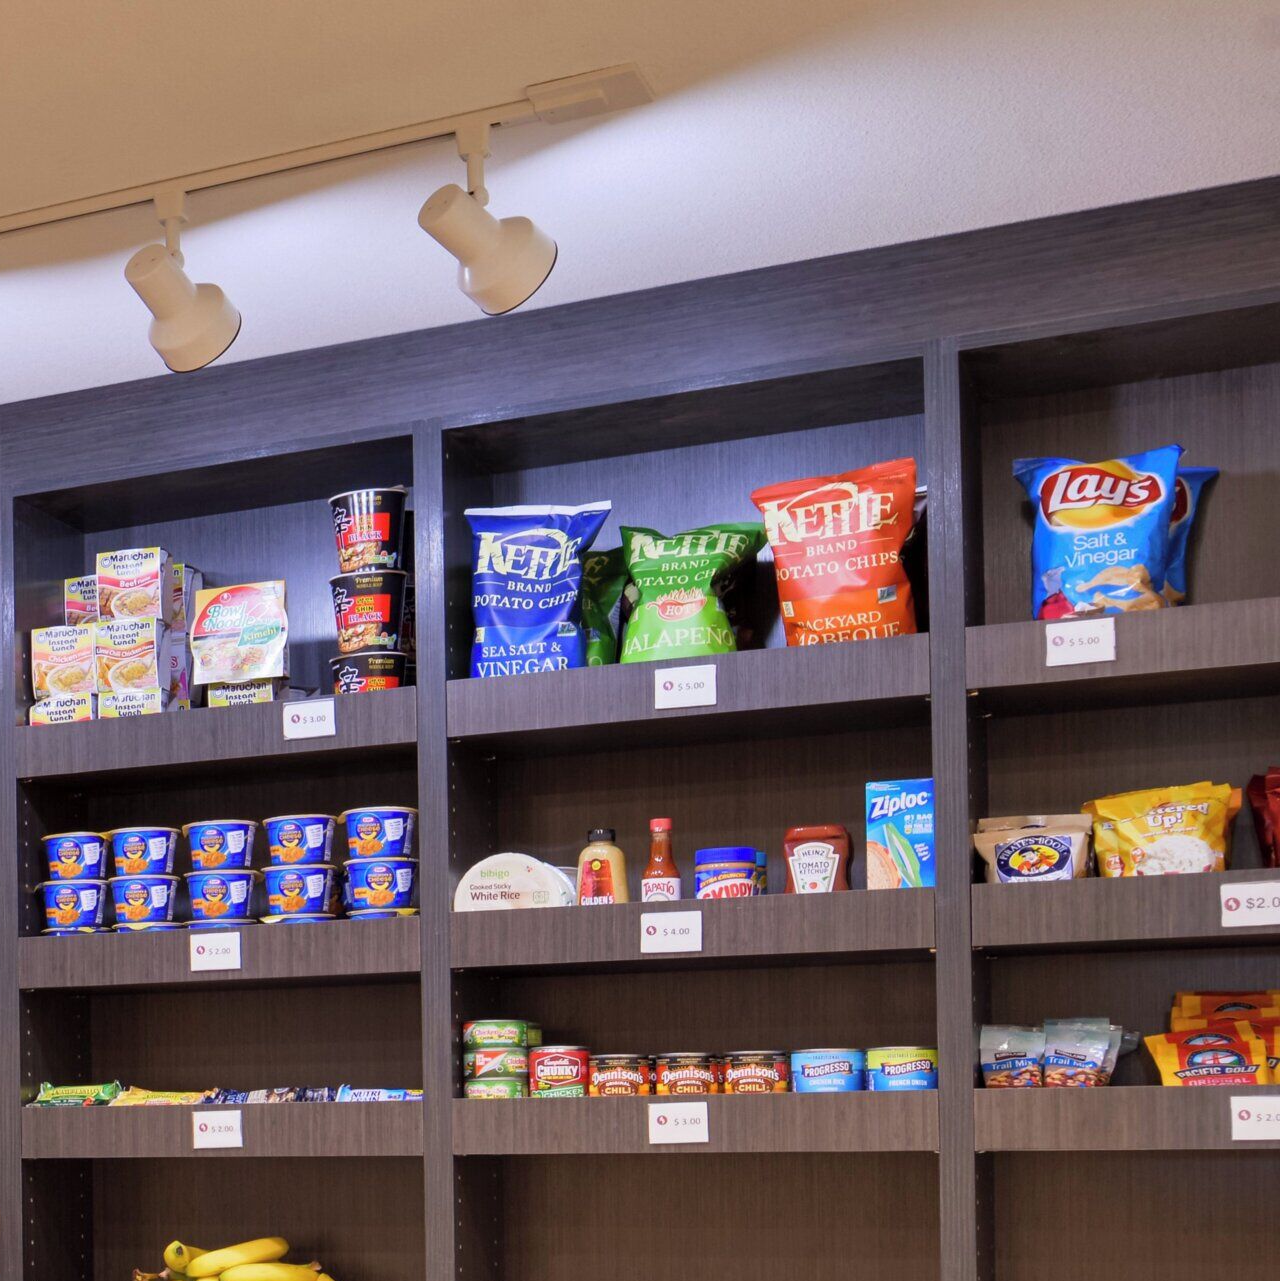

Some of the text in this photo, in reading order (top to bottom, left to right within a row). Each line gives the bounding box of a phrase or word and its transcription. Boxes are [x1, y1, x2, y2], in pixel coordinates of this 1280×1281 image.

[1049, 471, 1153, 513] Lay's
[760, 482, 899, 547] KETTLE
[1073, 532, 1127, 551] Salt &
[806, 539, 858, 557] BRAND
[110, 552, 154, 563] Maruchan
[473, 528, 582, 580] KETTLE
[1065, 547, 1138, 568] Vinegar
[661, 559, 710, 572] BRAND
[845, 551, 898, 571] CHIPS
[120, 580, 137, 588] Beef
[507, 581, 551, 593] BRAND
[474, 594, 533, 609] POTATO
[207, 601, 248, 619] Bowl
[107, 621, 150, 632] Maruchan
[201, 615, 256, 632] Noodle
[45, 627, 88, 639] Maruchan
[110, 631, 140, 640] Instant
[48, 637, 78, 646] Instant
[113, 638, 137, 646] Lunch
[1078, 636, 1100, 645] 5.00
[52, 643, 75, 652] Lunch
[482, 642, 562, 658] SEA SALT &
[476, 657, 569, 678] VINEGAR
[223, 681, 267, 692] Maruchan
[686, 681, 705, 690] 5.00
[225, 692, 256, 701] Instant
[47, 707, 76, 716] Instant
[115, 702, 145, 710] Instant
[50, 714, 74, 722] Lunch
[310, 715, 326, 723] 3.00
[871, 791, 929, 818] Ziploc
[1147, 813, 1182, 827] Up!
[801, 849, 825, 858] HEINZ
[798, 861, 830, 870] TOMATO
[480, 870, 509, 879] bibigo
[494, 883, 511, 891] Sticky
[470, 891, 520, 901] White Rice
[670, 928, 690, 936] 4.00
[992, 1060, 1033, 1070] Trail Mix
[1050, 1057, 1072, 1065] Trail
[537, 1065, 578, 1077] CHUNKY
[727, 1064, 779, 1081] Dennison's
[805, 1063, 850, 1077] PROGRESSO
[885, 1061, 931, 1075] PROGRESSO
[1178, 1064, 1259, 1078] PACIFIC GOLD
[592, 1070, 643, 1086] Dennison's
[662, 1066, 714, 1082] Dennison's
[605, 1086, 631, 1094] CHILI
[739, 1084, 765, 1092] CHILI
